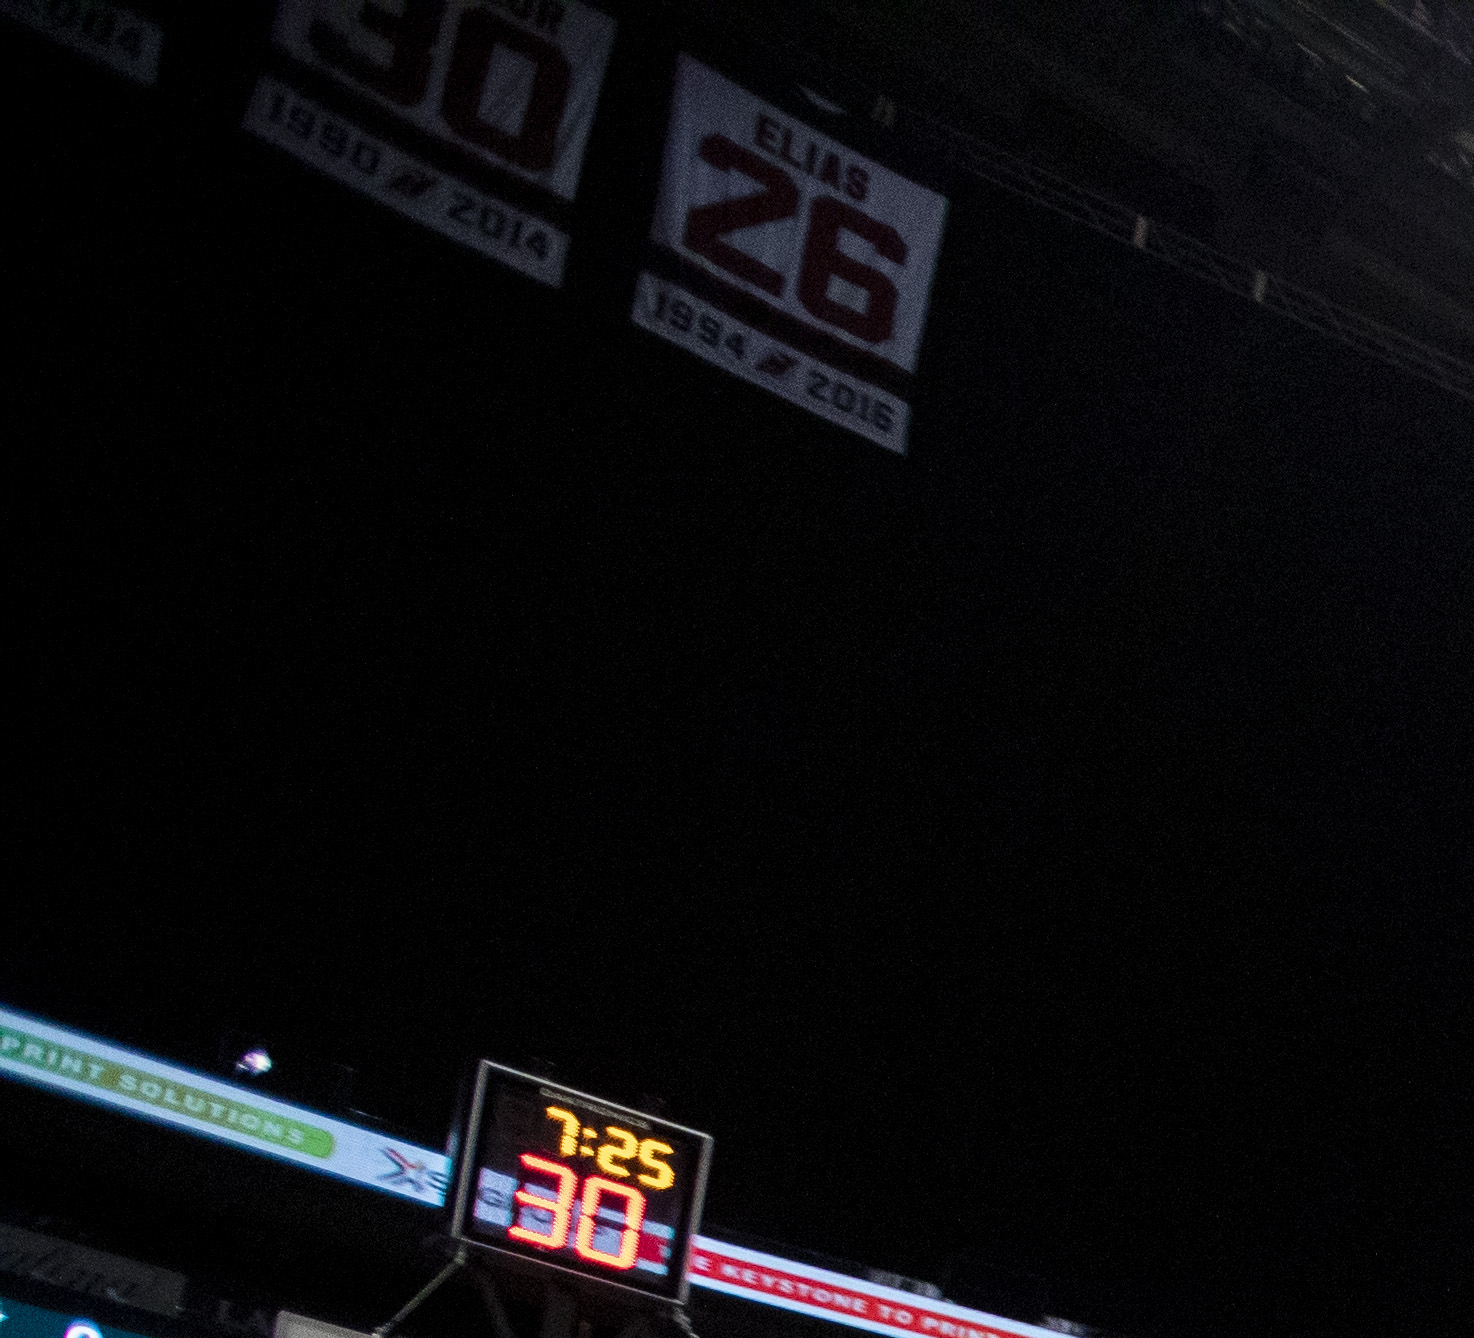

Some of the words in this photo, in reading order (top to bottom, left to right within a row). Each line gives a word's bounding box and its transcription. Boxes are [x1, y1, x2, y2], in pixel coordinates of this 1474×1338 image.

[308, 0, 574, 170] 30
[267, 90, 381, 177] 1990
[451, 188, 553, 262] 2014
[756, 111, 869, 203] ELIAS
[682, 133, 906, 344] 26
[649, 289, 746, 360] 1994
[808, 367, 895, 434] 2016
[0, 1036, 106, 1080] PRINT
[119, 1073, 306, 1145] SOLUTIONS
[547, 1105, 674, 1189] 7:25
[509, 1152, 648, 1271] 30
[721, 1263, 869, 1313] KEYSTONE
[877, 1304, 913, 1326] TO
